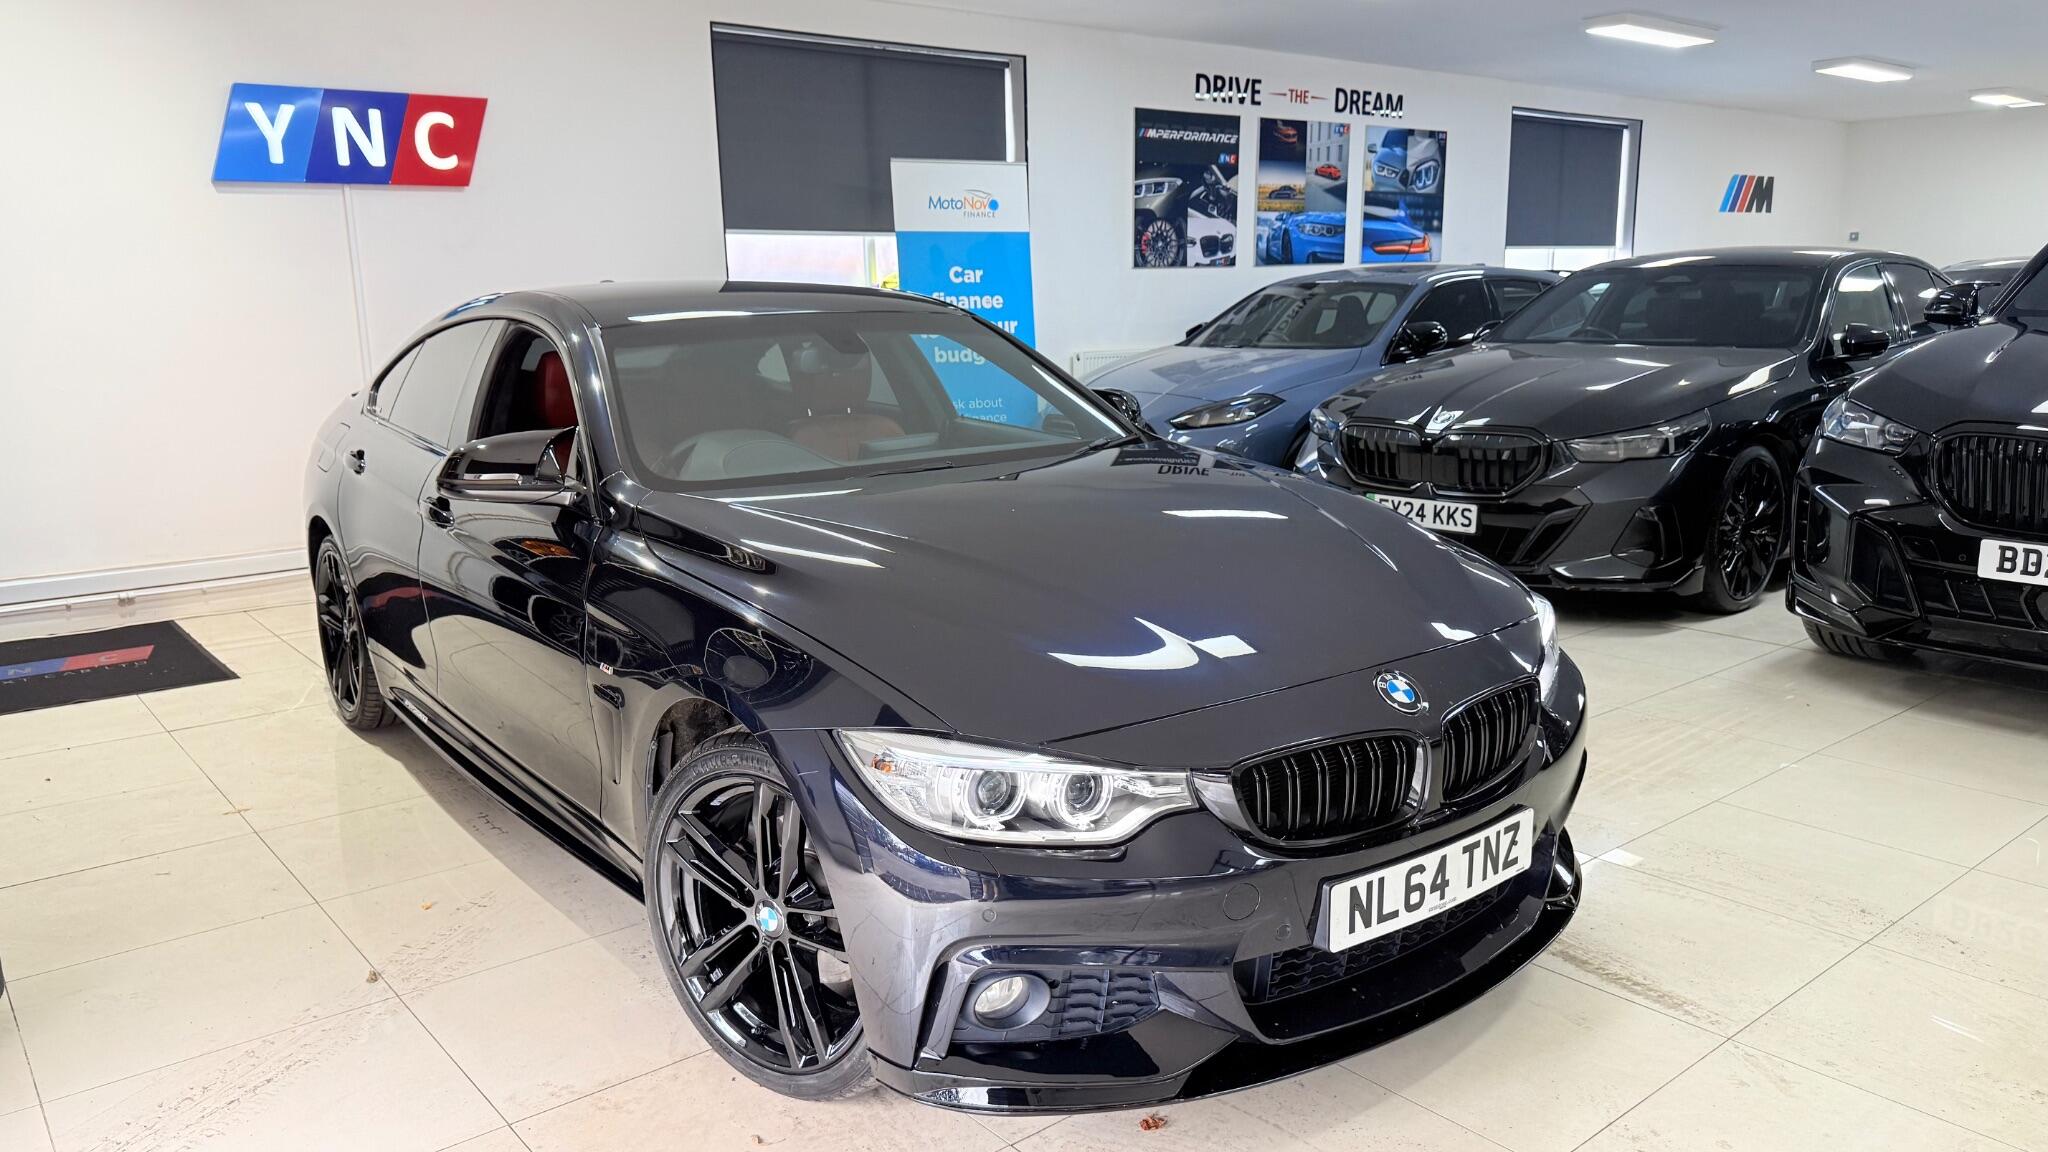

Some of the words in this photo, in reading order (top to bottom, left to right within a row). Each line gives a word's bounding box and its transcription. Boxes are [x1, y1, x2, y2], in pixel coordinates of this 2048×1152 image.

[1195, 73, 1262, 105] DRIVE
[1288, 88, 1310, 104] THE
[1334, 87, 1404, 119] DREAM
[244, 102, 459, 171] YNC
[949, 266, 984, 284] Car
[934, 346, 986, 365] budg
[969, 397, 1003, 409] about
[1432, 504, 1473, 528] KKS
[1348, 854, 1450, 935] NL64
[1462, 820, 1521, 889] TNZ
